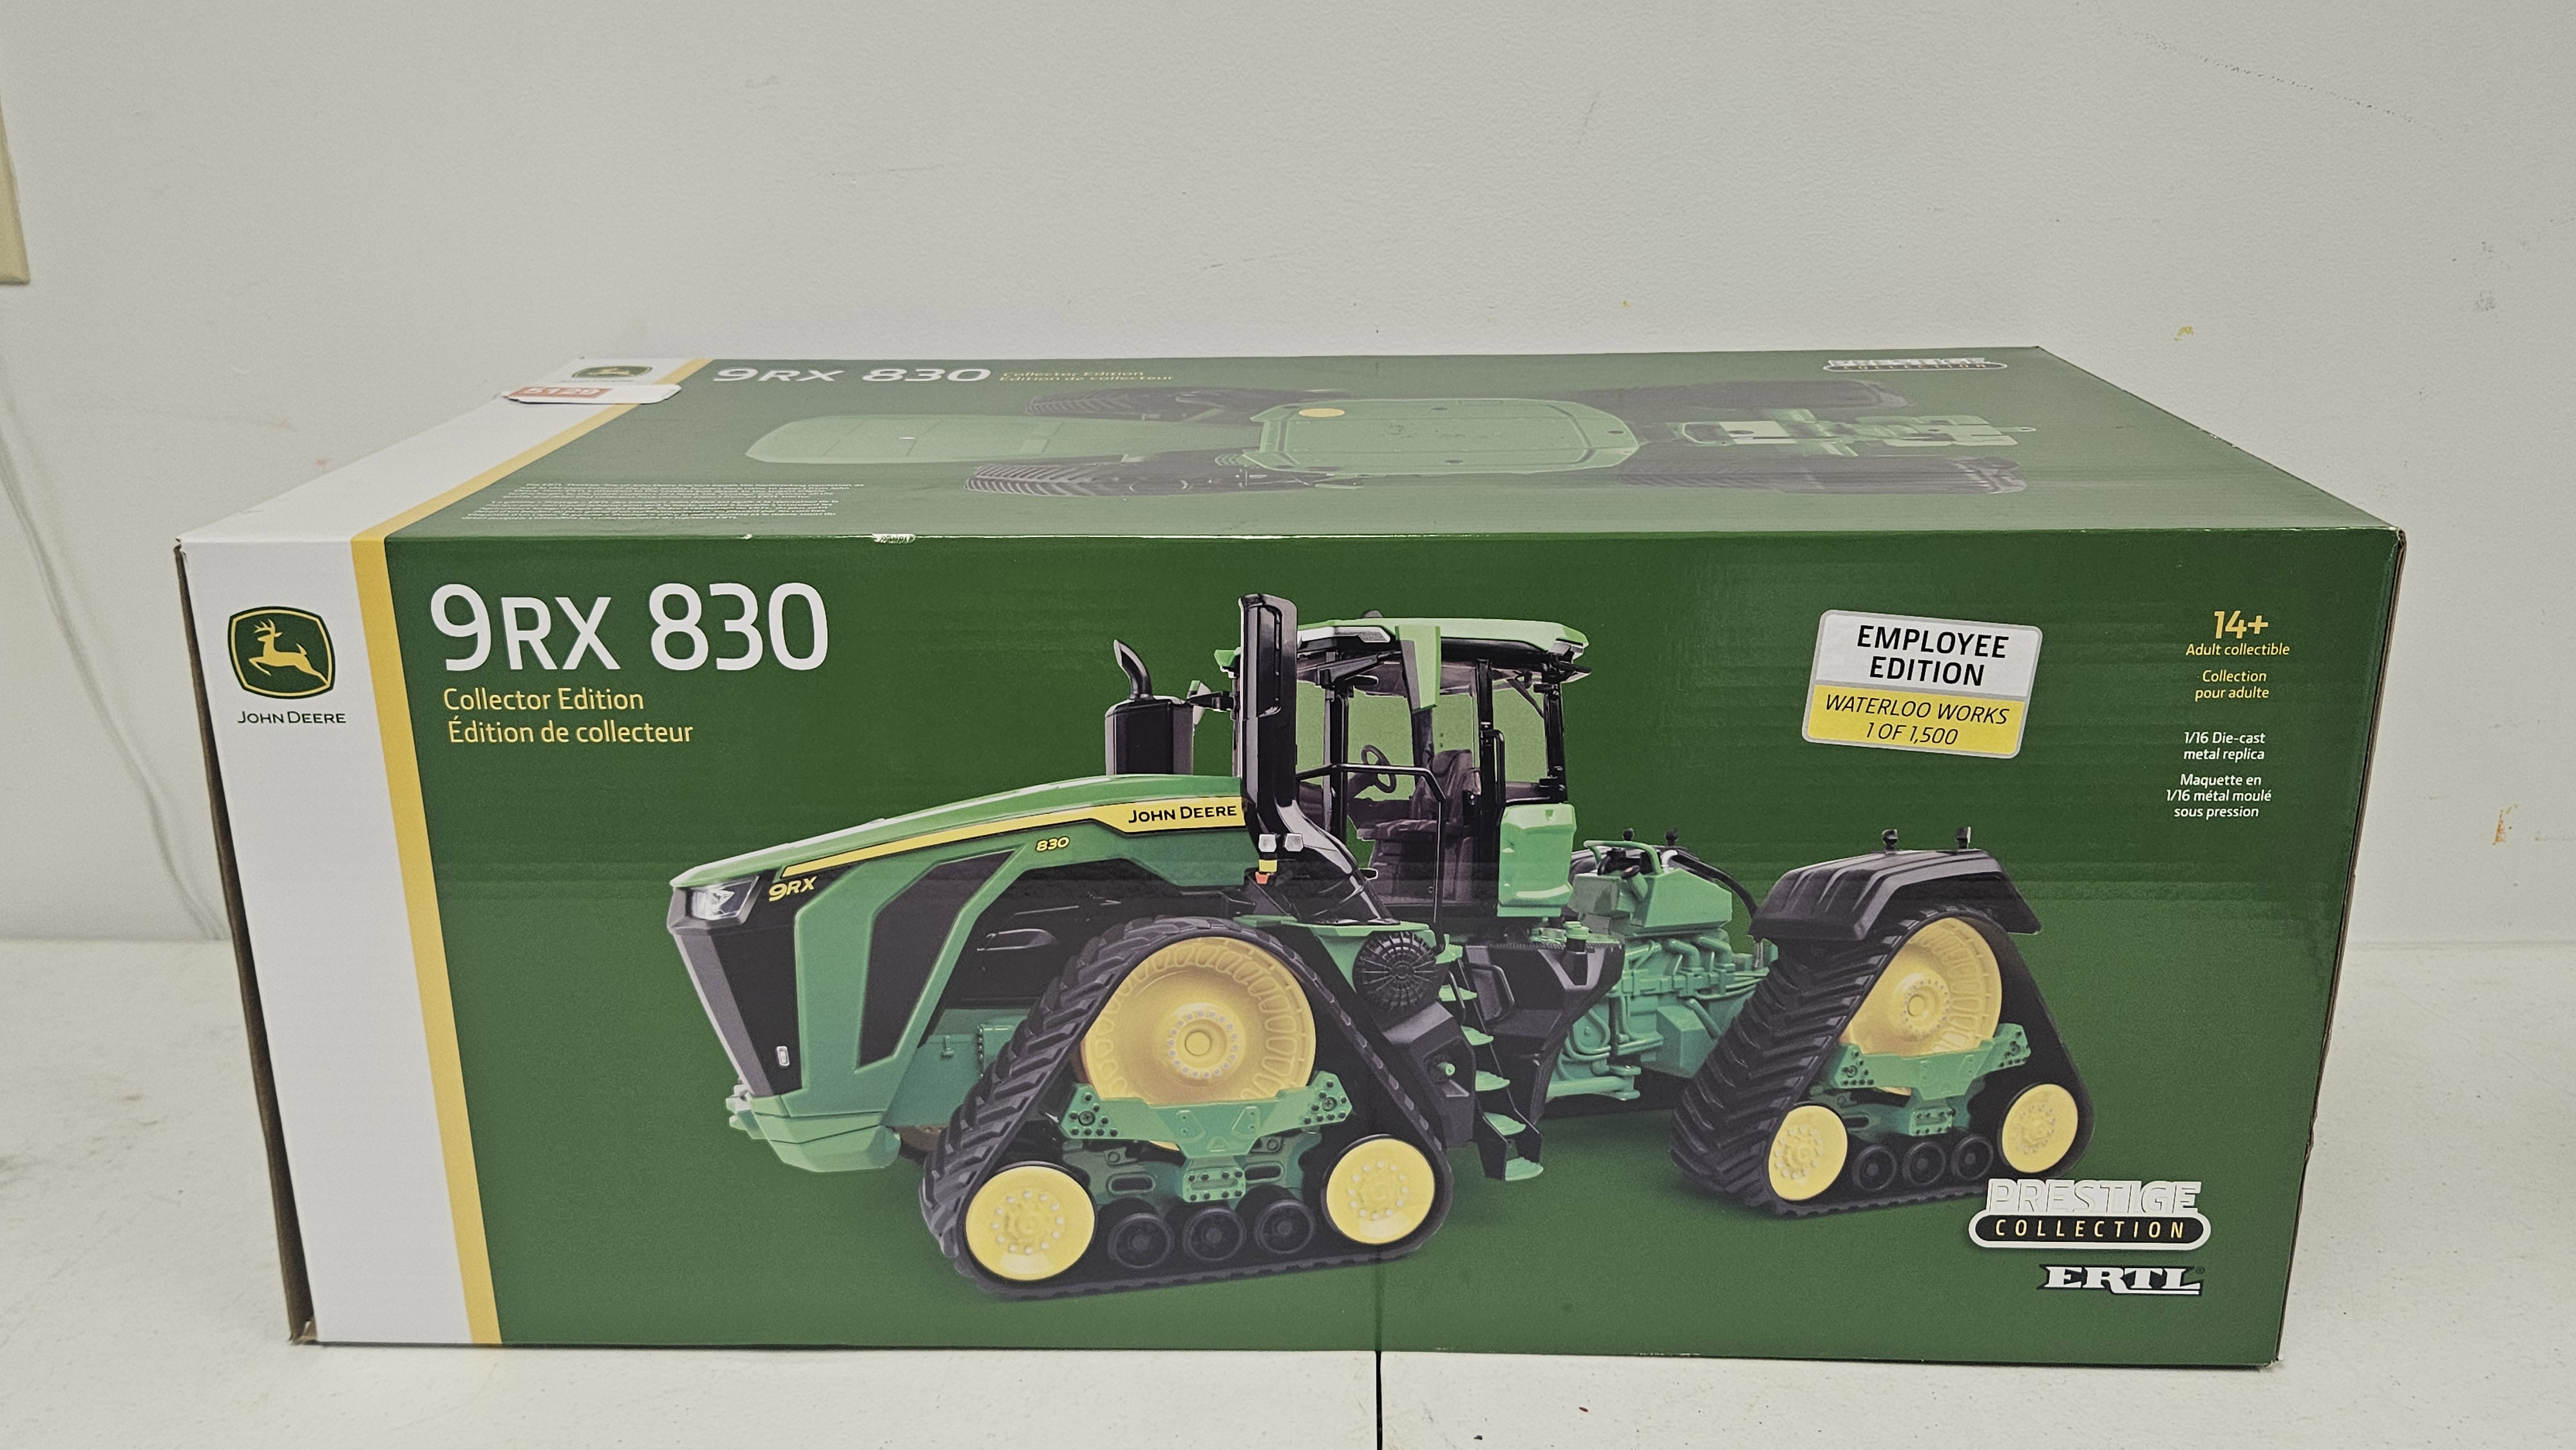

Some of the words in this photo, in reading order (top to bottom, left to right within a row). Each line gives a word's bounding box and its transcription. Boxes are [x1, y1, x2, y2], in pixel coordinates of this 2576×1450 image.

[714, 368, 845, 381] 9RX
[862, 368, 991, 381] 830
[430, 583, 621, 671] 9RX
[649, 582, 829, 671] 830
[2214, 610, 2268, 639] 14+
[1857, 625, 2009, 658] EMPLOYEE
[2185, 643, 2221, 655] Adult
[2224, 643, 2290, 655] collectible
[1870, 656, 1985, 686] EDITION
[2202, 670, 2267, 682] Collection
[443, 688, 551, 710] Collector
[558, 688, 644, 710] Edition
[2195, 689, 2226, 702] pour
[2228, 686, 2269, 698] adulte
[237, 711, 285, 724] JOHN
[287, 711, 346, 724] DEERE
[1826, 694, 1931, 718] WATERLOO
[1937, 703, 2010, 724] WORKS
[448, 715, 535, 744] Édition
[540, 720, 569, 742] de
[576, 719, 694, 743] collecteur
[1866, 722, 1873, 739] 1
[1878, 723, 1907, 740] OF
[1909, 726, 1958, 745] 1,500
[2184, 731, 2209, 744] 1/16
[2211, 731, 2266, 744] Die-cast
[2183, 747, 2220, 760] metal
[2222, 747, 2265, 763] replica
[2180, 773, 2243, 789] Maquette
[2246, 776, 2262, 786] en
[2166, 789, 2190, 802] 1/16
[2193, 789, 2230, 802] métal
[2232, 789, 2272, 802] moulé
[1128, 807, 1176, 824] JOHN
[1180, 804, 1238, 820] DEERE
[2174, 807, 2204, 817] sous
[2206, 805, 2259, 820] pression
[1036, 836, 1070, 852] 830
[768, 876, 815, 902] 9RX
[1987, 1178, 2202, 1214] PRESTIGE
[1995, 1219, 2184, 1238] COLLECTION
